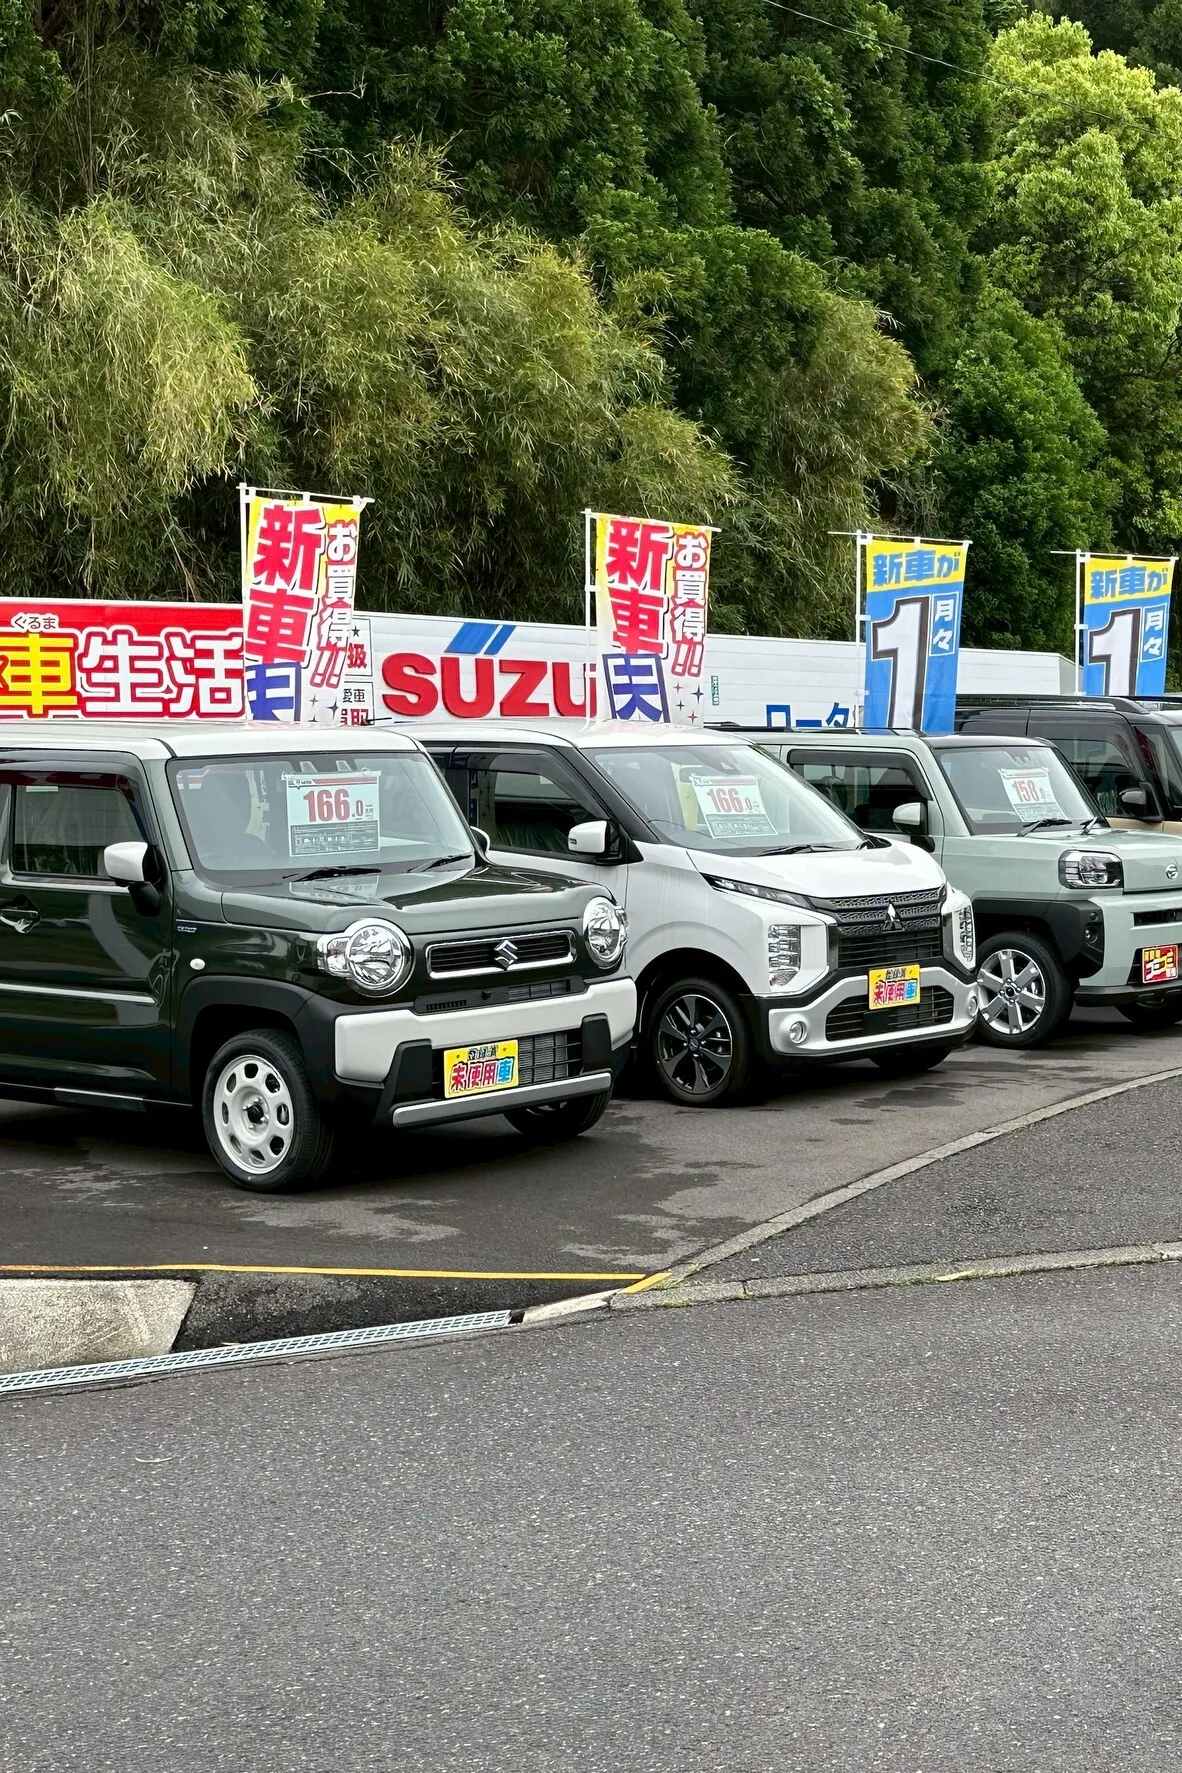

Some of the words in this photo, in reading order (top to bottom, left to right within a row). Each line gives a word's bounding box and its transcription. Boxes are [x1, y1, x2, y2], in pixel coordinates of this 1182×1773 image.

[606, 519, 670, 655] 新車
[873, 550, 960, 586] 新車が
[1090, 566, 1168, 599] 新車が
[933, 599, 954, 650] 月々
[1089, 608, 1141, 695] 1
[1144, 610, 1164, 656] 月々
[0, 633, 243, 714] 車生活
[872, 596, 930, 731] 1
